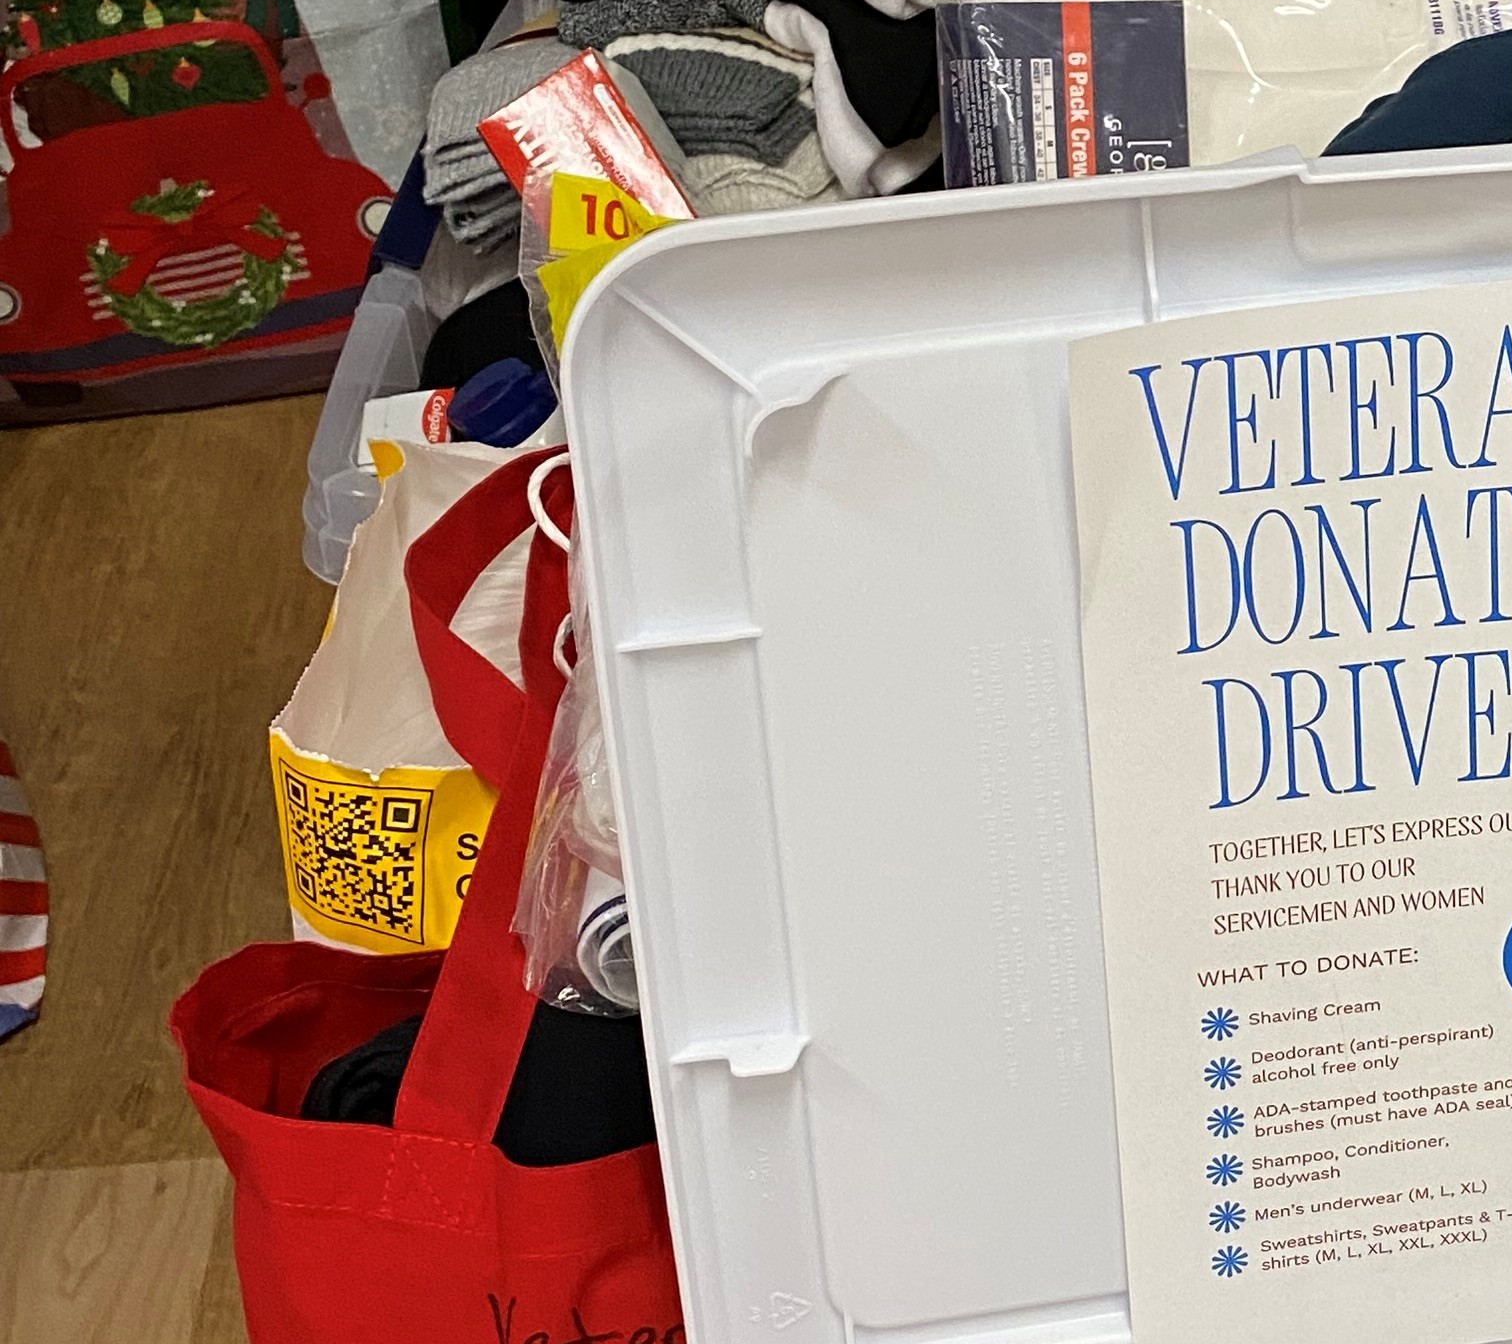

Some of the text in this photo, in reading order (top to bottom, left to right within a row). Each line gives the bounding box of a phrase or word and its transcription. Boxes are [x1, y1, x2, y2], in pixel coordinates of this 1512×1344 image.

[1068, 53, 1087, 65] 6
[1069, 71, 1091, 124] Pack
[427, 395, 446, 442] Colgate
[1202, 649, 1512, 809] DRIVE
[1209, 831, 1328, 863] TOGETHER,
[1332, 824, 1386, 849] LET'S
[1392, 814, 1484, 843] EXPRESS
[1211, 857, 1416, 900] THANK YOU TO OUR
[1213, 886, 1486, 936] SERVICEMEN AND WOMEN
[1198, 947, 1420, 988] WHAT TO DONATE:
[1248, 999, 1382, 1027] Shaving Cream
[1252, 1023, 1494, 1065] Deodorant (anti-perspirant)
[1252, 1054, 1400, 1085] alcohol free only
[1253, 1091, 1378, 1119] ADA-stamped
[1382, 1080, 1479, 1104] toothpaste
[1255, 1117, 1325, 1138] brushes
[1330, 1109, 1383, 1131] (must
[1388, 1105, 1428, 1123] have
[1433, 1100, 1471, 1116] ADA
[1251, 1135, 1451, 1171] Shampoo, Conditioner,
[1252, 1166, 1341, 1190] Bodywash
[1255, 1179, 1489, 1222] Men's underwear (M, L, XL)
[1260, 1227, 1367, 1252] Sweatshirts,
[1372, 1213, 1474, 1238] Sweatpants
[1479, 1211, 1491, 1224] &
[1261, 1228, 1489, 1272] shirts (M, L, XL, XXL, XXXL)
